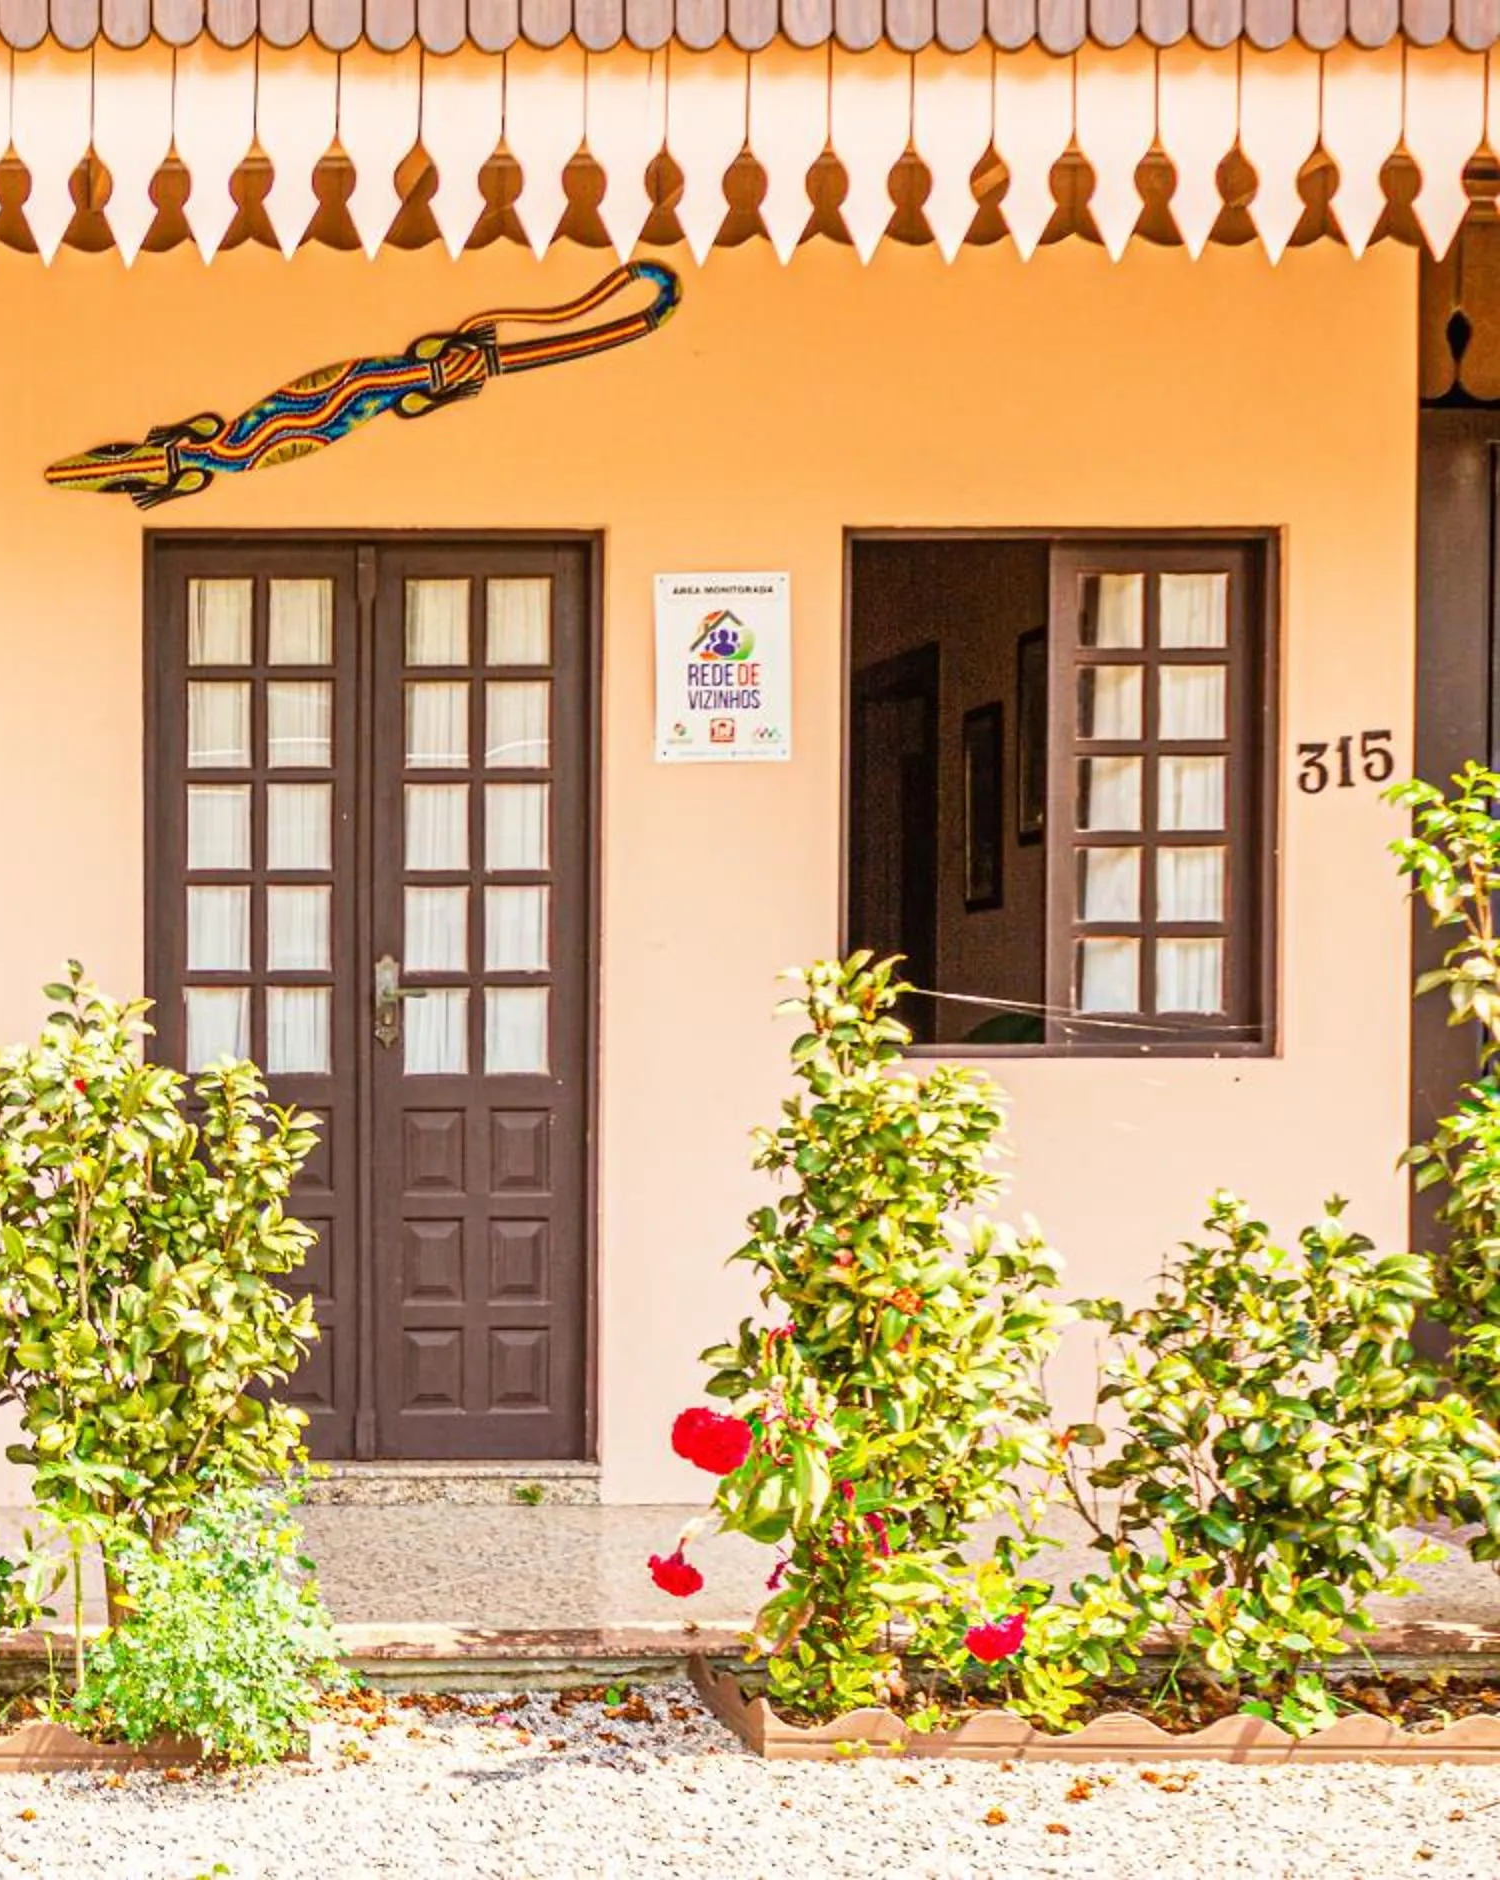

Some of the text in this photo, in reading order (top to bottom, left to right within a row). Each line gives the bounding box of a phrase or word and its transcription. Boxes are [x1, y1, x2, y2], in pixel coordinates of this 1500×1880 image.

[704, 585, 774, 594] MONITORADA
[687, 663, 761, 686] REDE DE
[688, 690, 761, 710] VIZINHOS
[1297, 729, 1394, 794] 315
